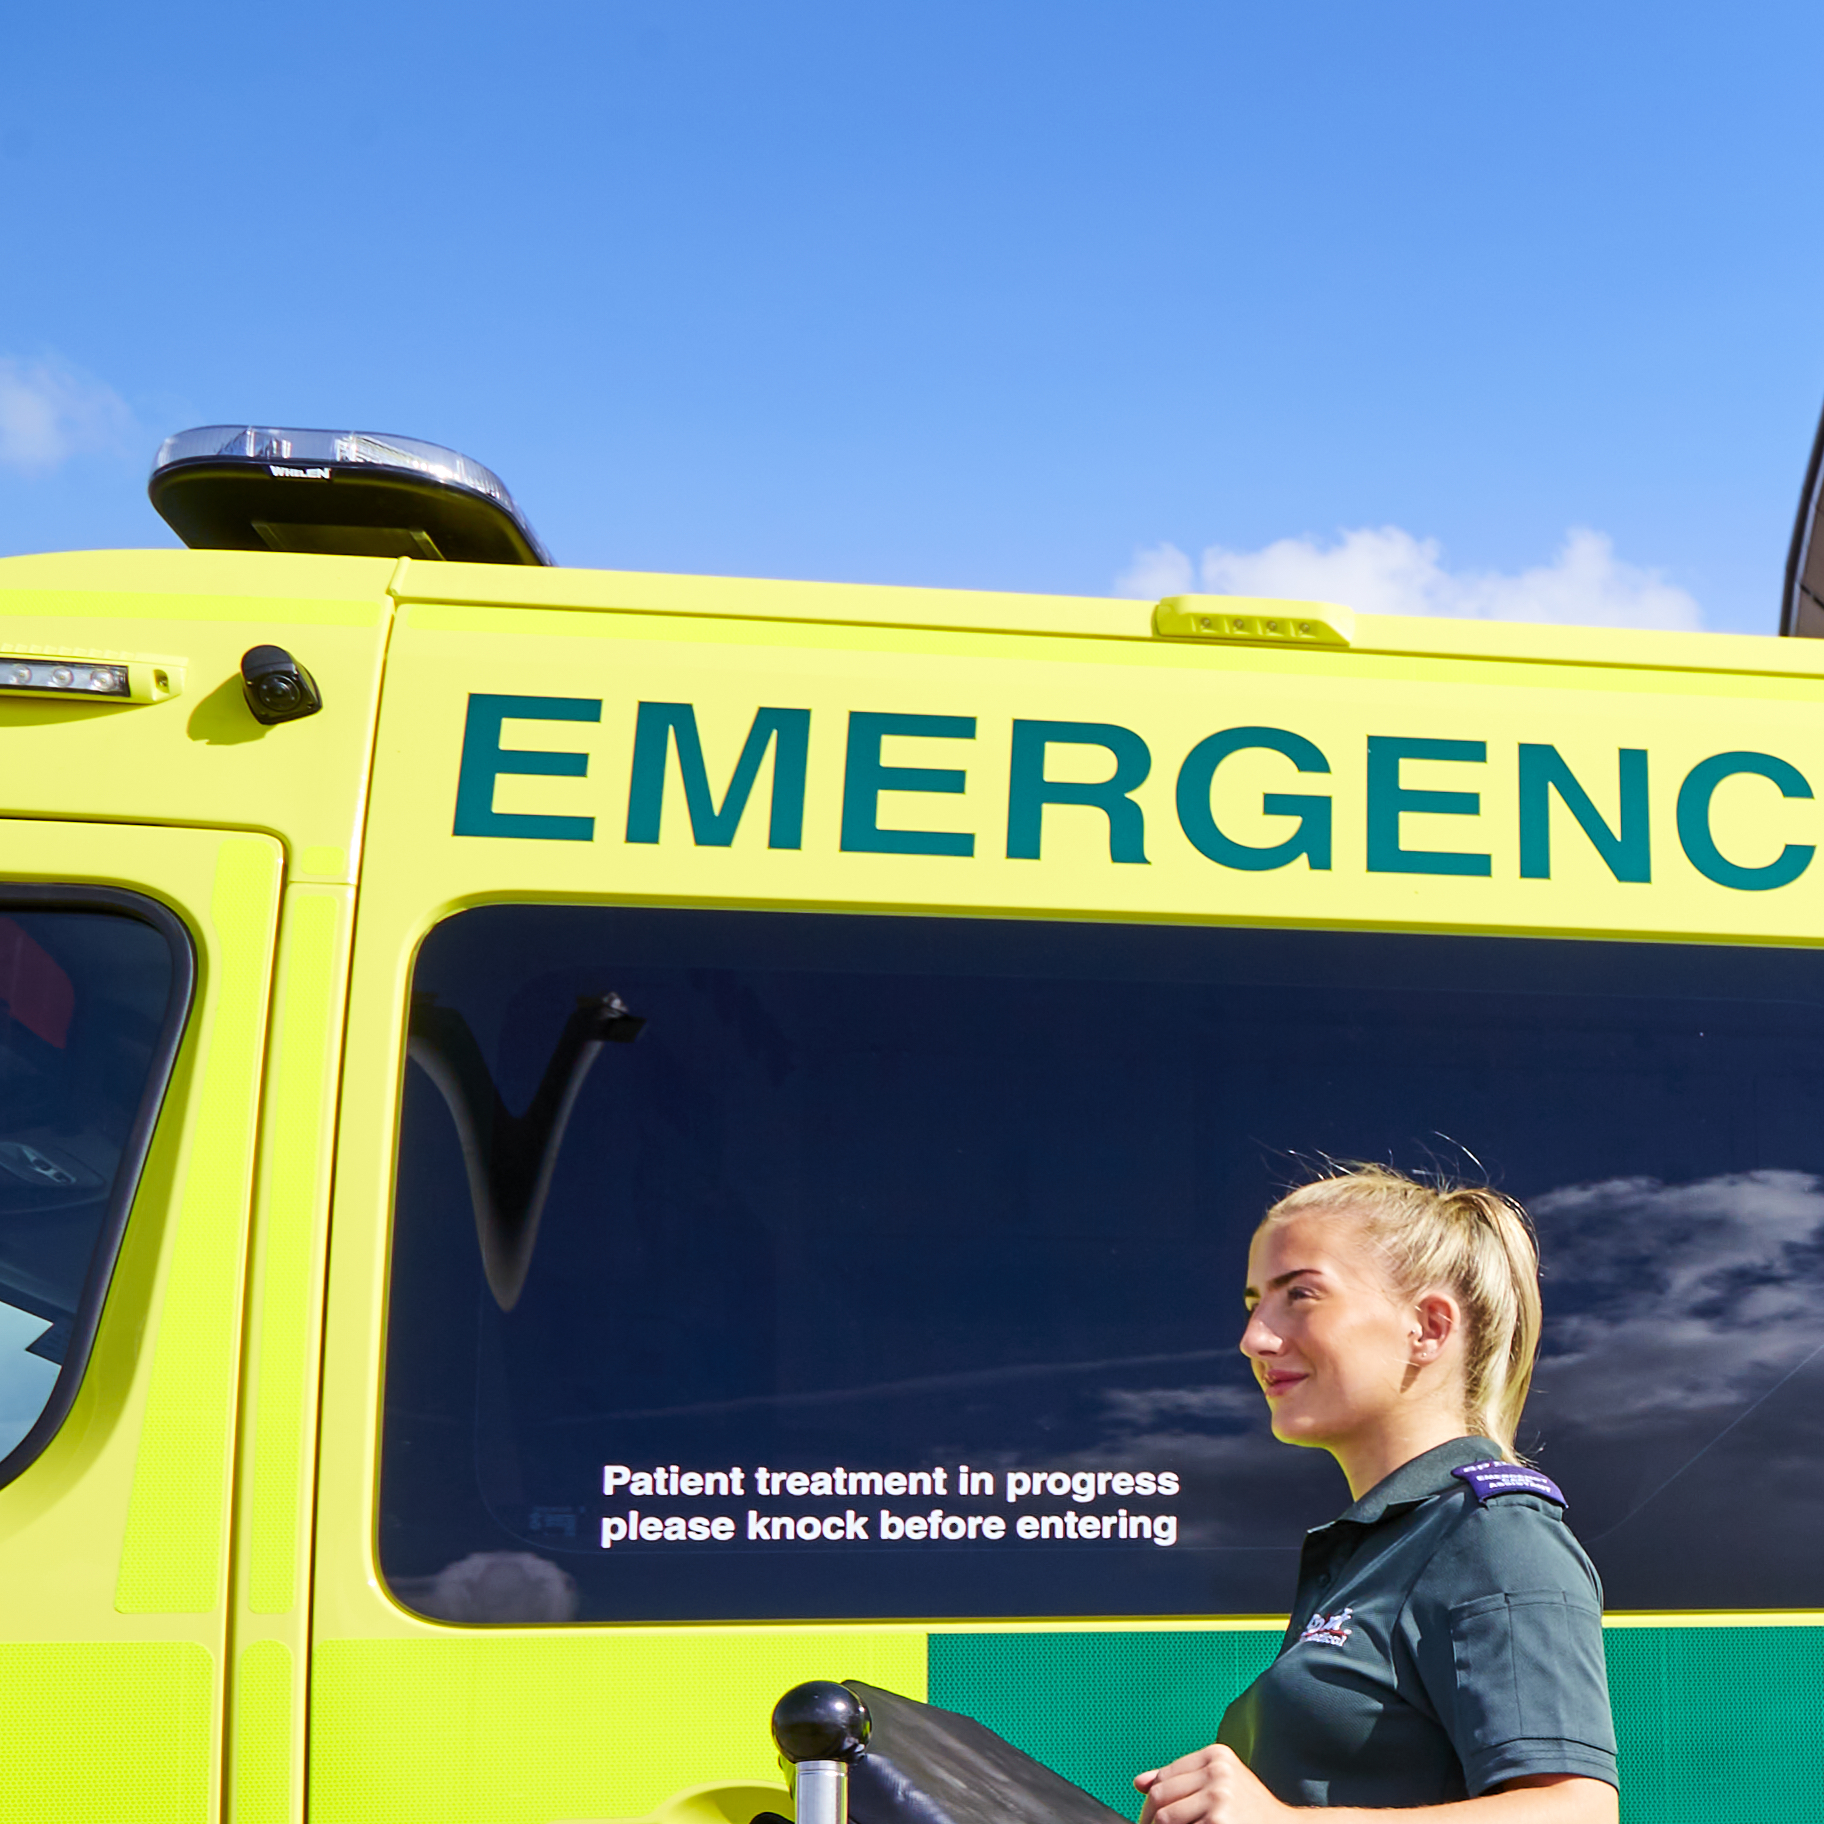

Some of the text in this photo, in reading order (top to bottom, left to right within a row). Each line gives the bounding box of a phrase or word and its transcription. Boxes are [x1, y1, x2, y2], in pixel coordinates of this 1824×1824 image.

[269, 464, 332, 479] WHELEN
[603, 1465, 1181, 1503] Patient treatment in progress
[601, 1510, 736, 1548] please
[747, 1510, 870, 1542] knock
[880, 1510, 1006, 1542] before
[1016, 1508, 1179, 1546] entering
